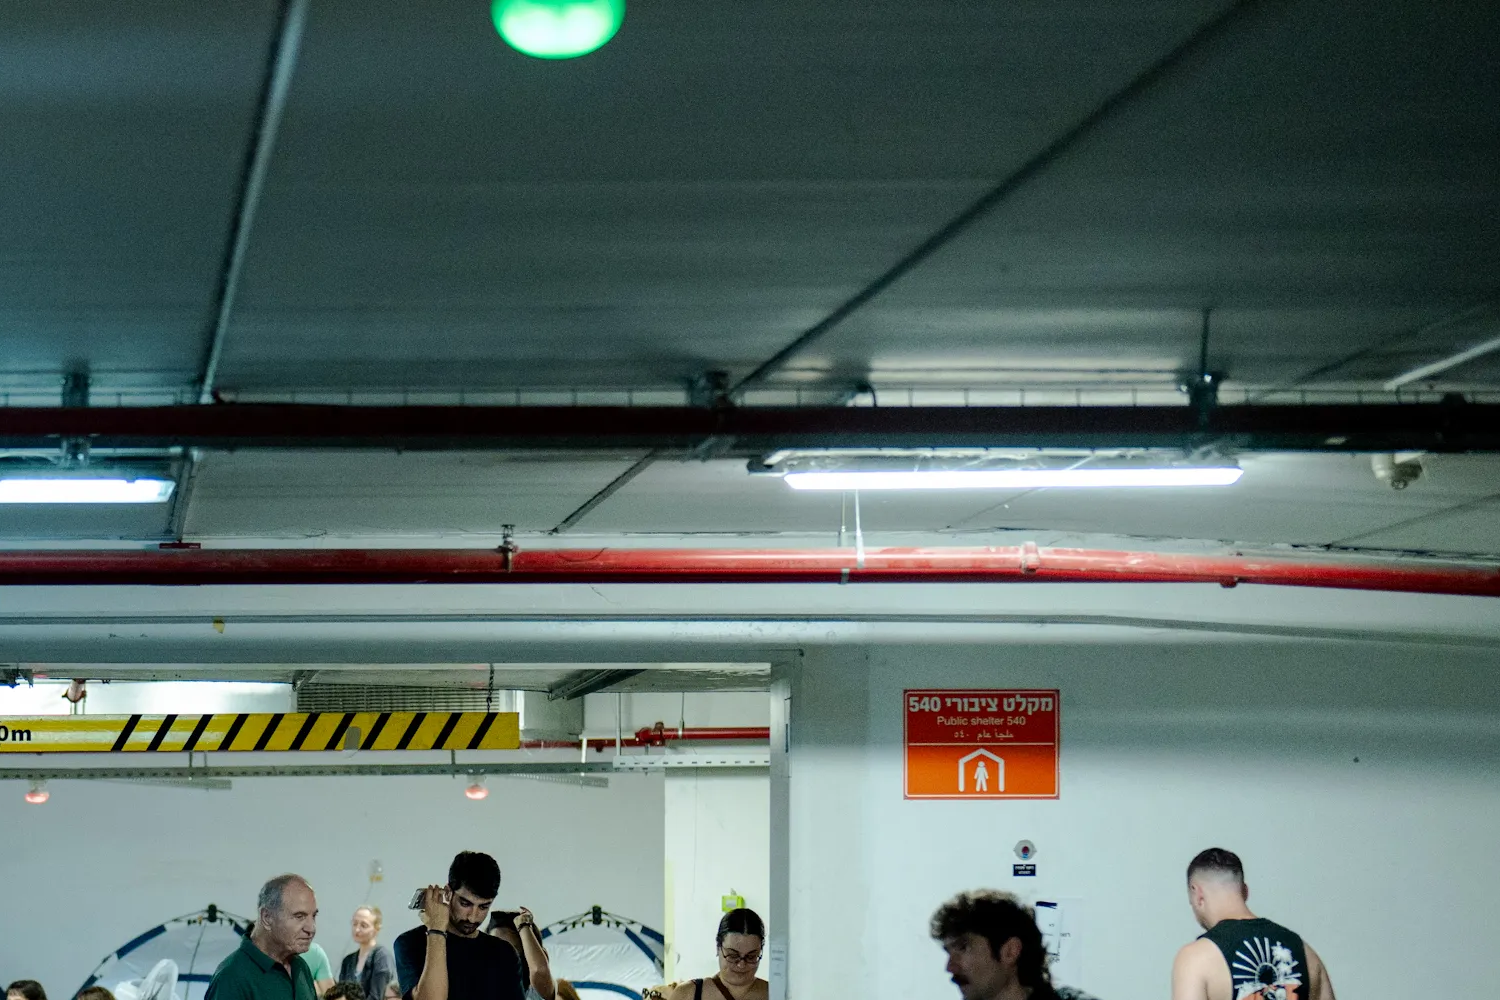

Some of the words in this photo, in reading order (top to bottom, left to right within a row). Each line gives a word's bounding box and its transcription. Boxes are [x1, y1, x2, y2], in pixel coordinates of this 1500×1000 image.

[909, 696, 941, 713] 540
[945, 697, 998, 712] ציבורי
[1002, 694, 1053, 716] מקלט
[936, 716, 969, 726] Public
[970, 716, 1004, 726] shelter
[1007, 716, 1026, 726] 540
[977, 729, 992, 742] عام
